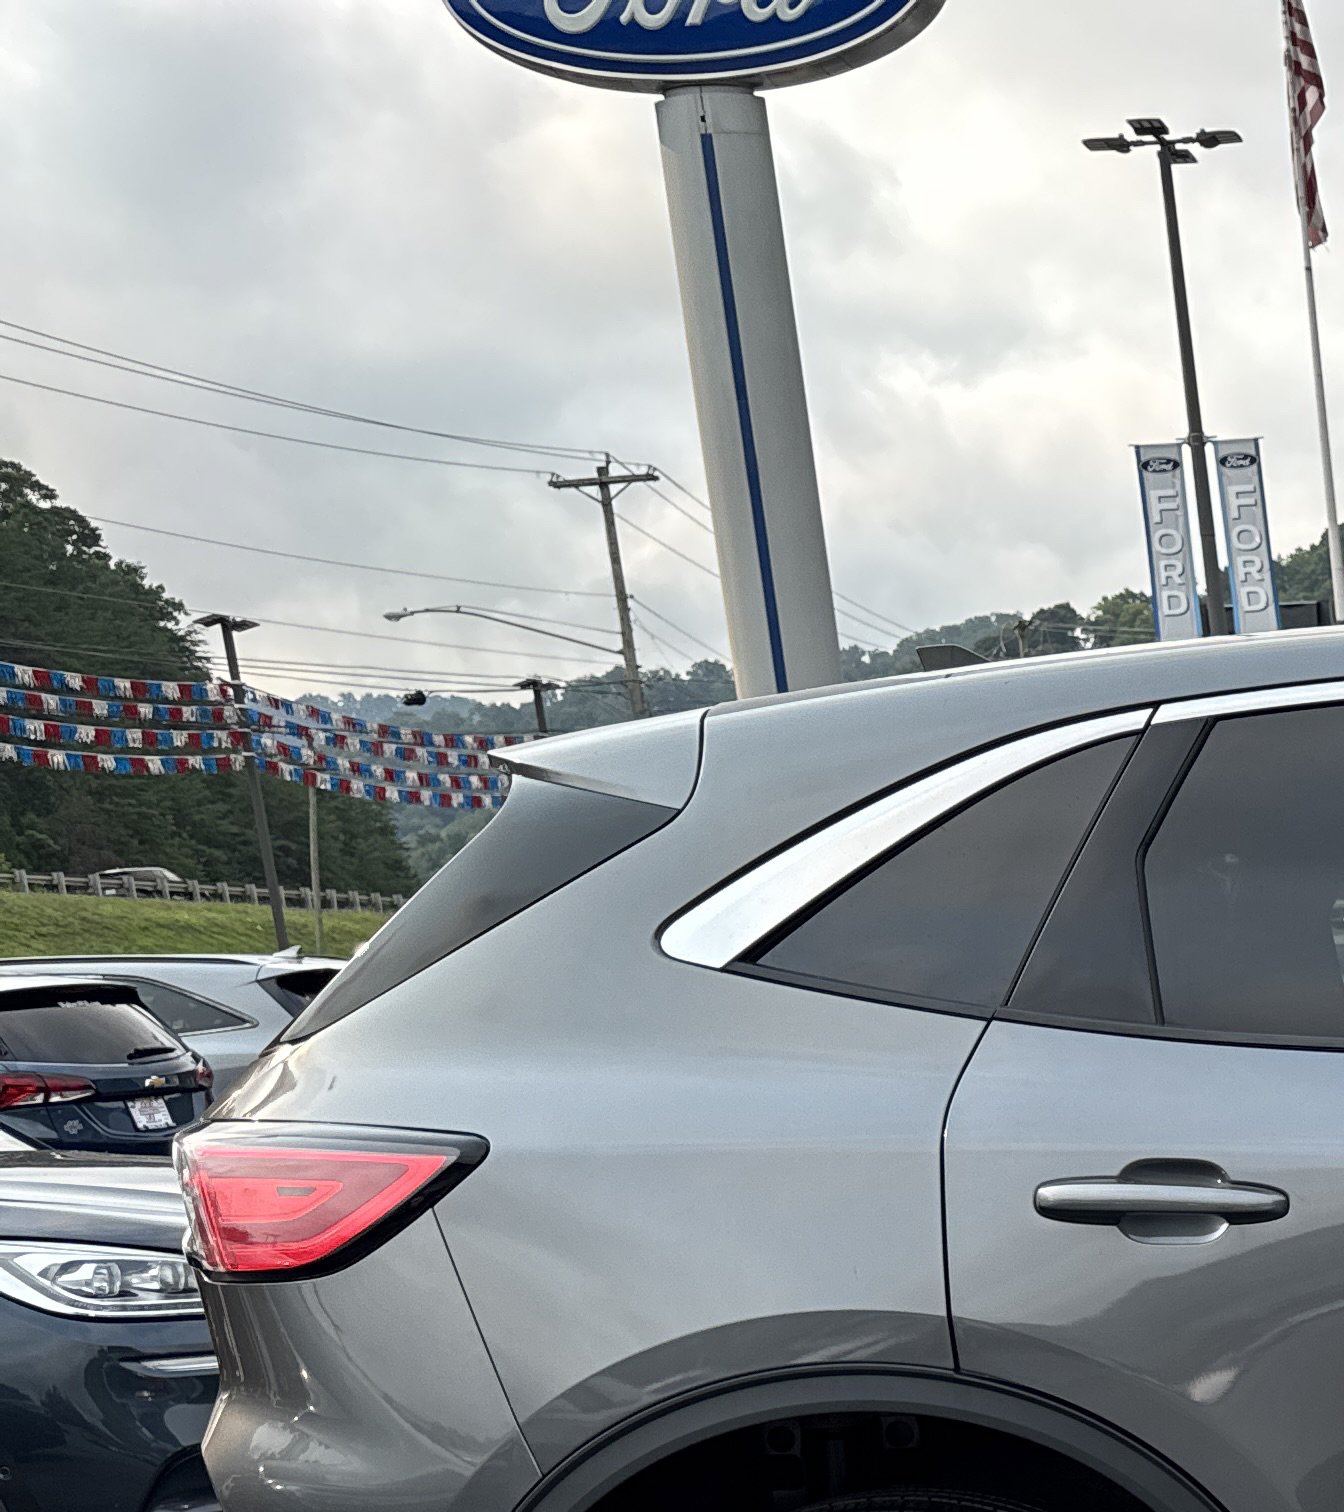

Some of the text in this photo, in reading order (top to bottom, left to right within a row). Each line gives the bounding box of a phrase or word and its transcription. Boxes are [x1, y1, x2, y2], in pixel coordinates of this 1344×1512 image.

[1147, 459, 1174, 472] Ford
[1225, 455, 1251, 468] Ford
[1153, 489, 1190, 617] FORD
[1233, 485, 1269, 613] FORD
